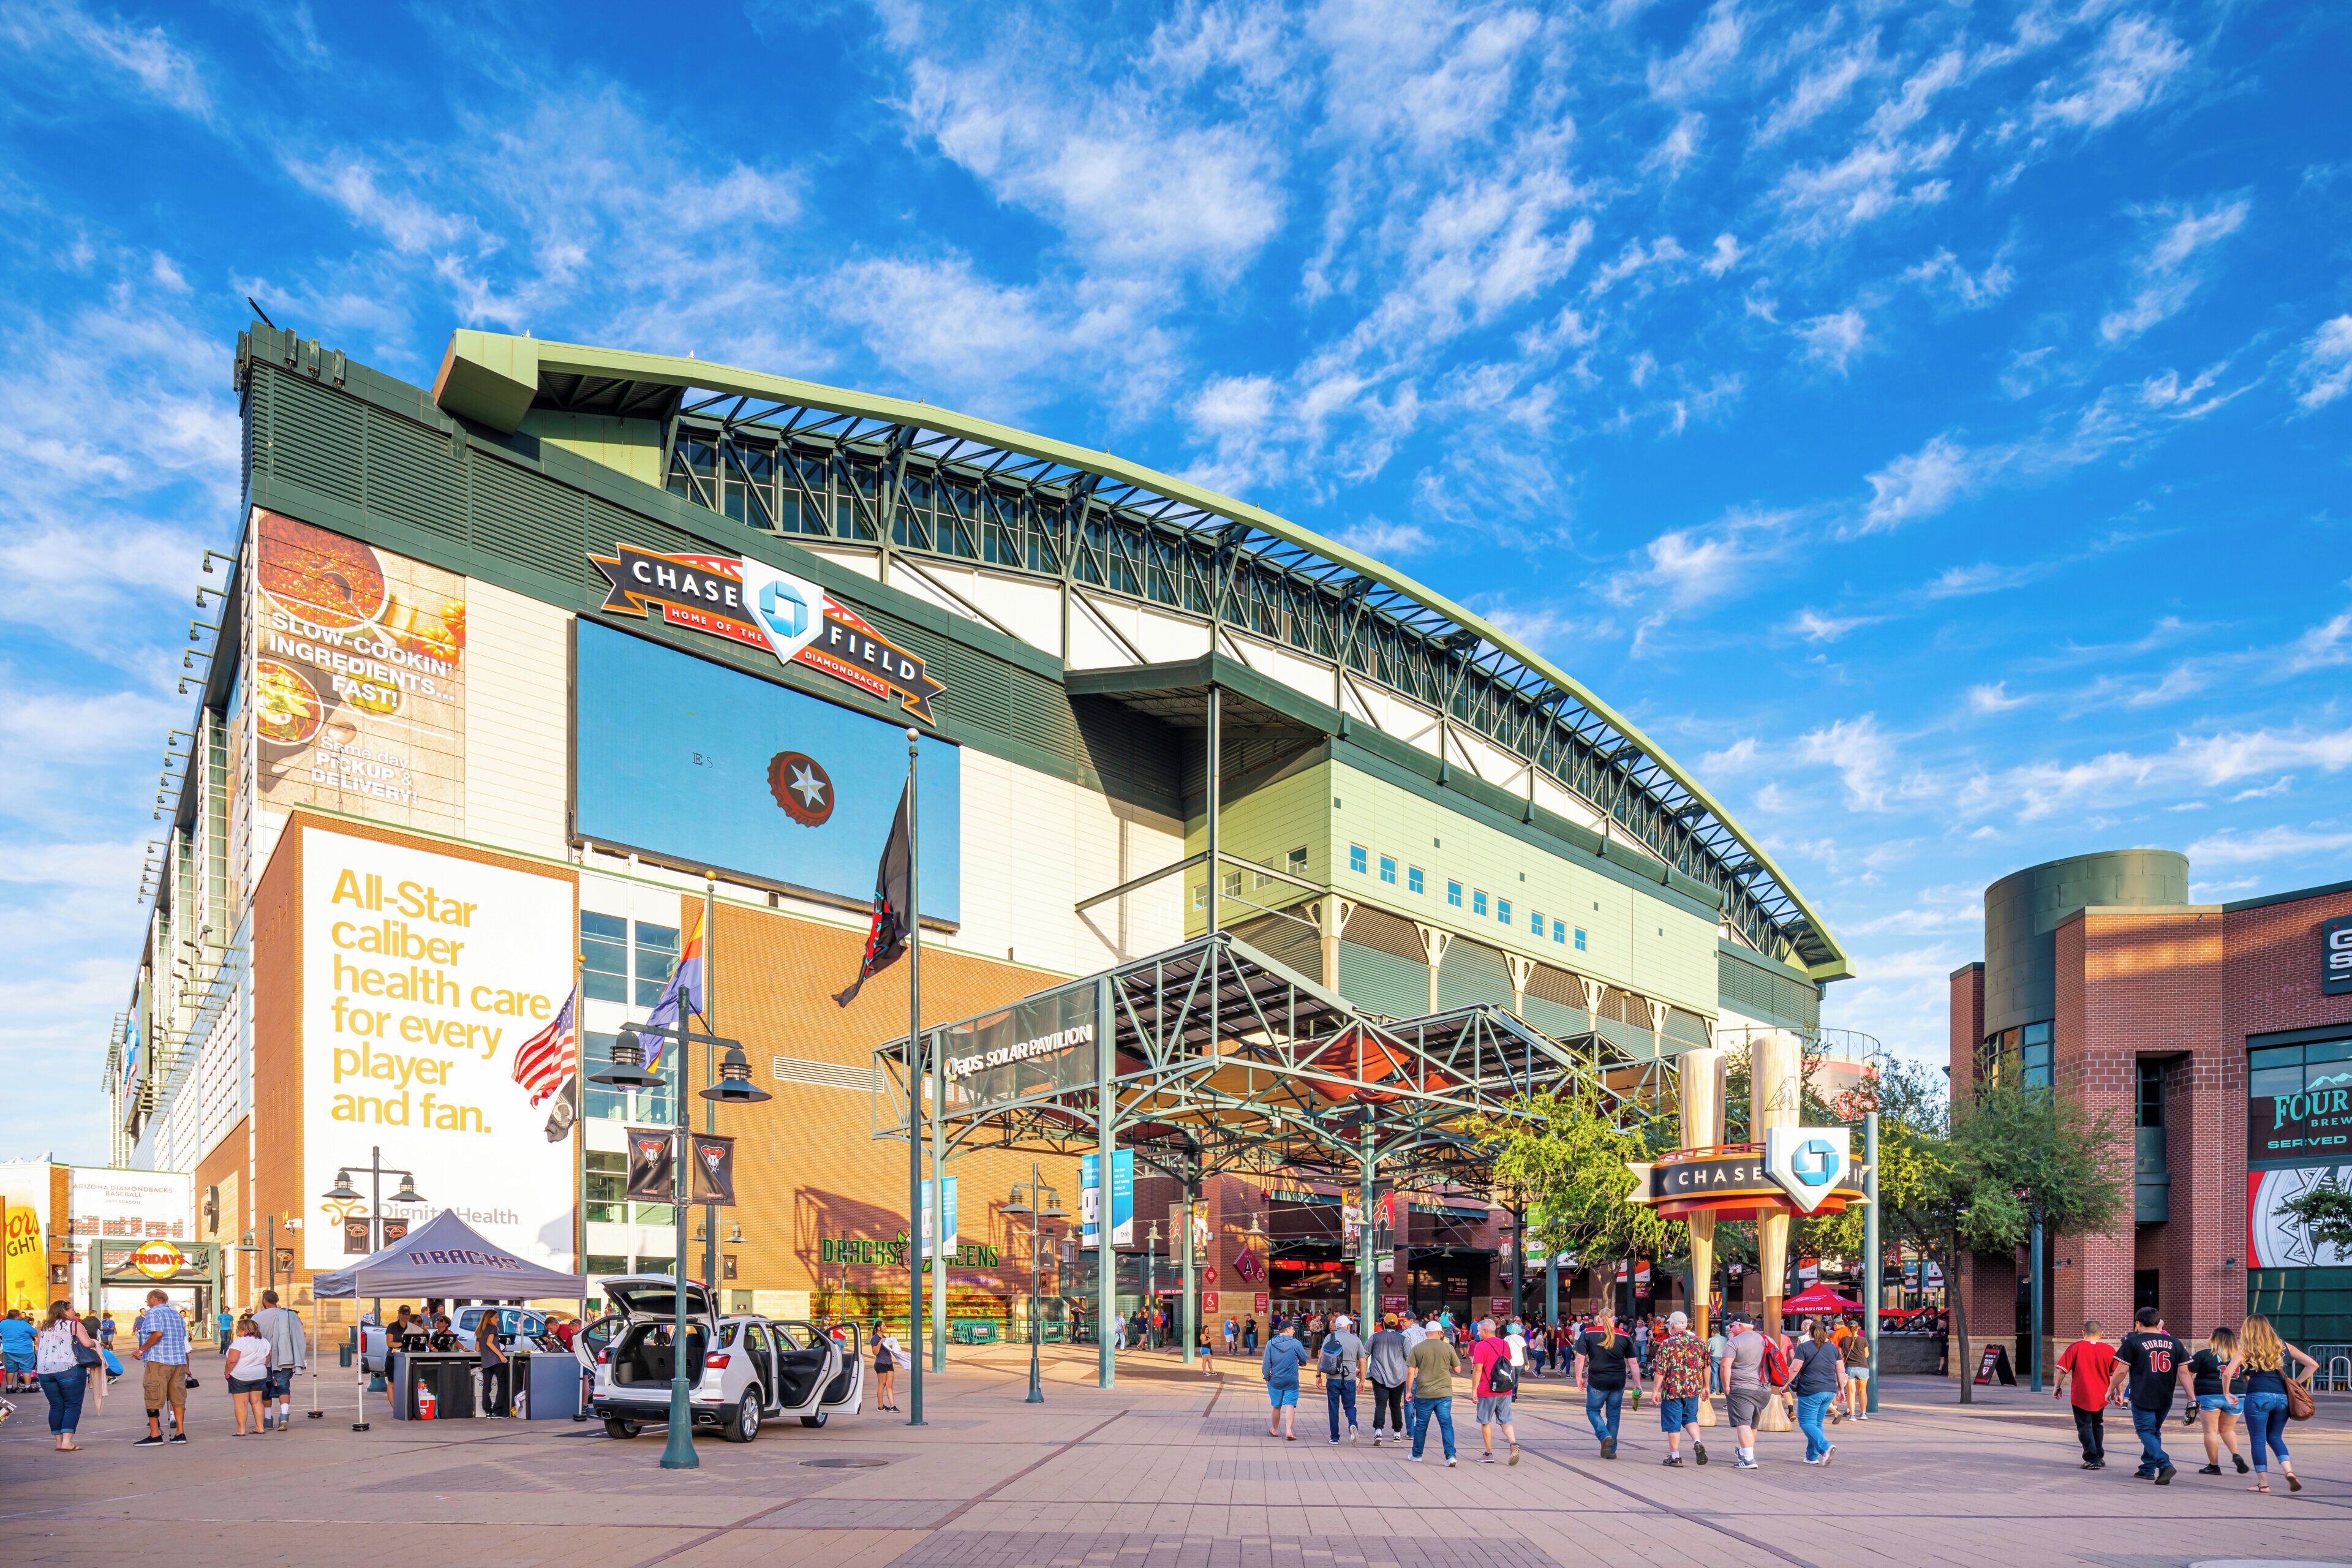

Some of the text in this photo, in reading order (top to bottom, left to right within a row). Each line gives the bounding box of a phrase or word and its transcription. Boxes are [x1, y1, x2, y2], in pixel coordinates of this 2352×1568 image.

[632, 560, 739, 608] CHASE
[271, 612, 453, 678] SLOW-COOKIN'
[671, 608, 763, 643] HOME OF THE
[270, 634, 454, 701] INGREDIENTS...
[804, 650, 885, 692] DIAMONDBACKS
[829, 628, 916, 682] FIELD
[332, 675, 398, 707] FAST!
[321, 736, 409, 772] Same day
[311, 767, 418, 805] DELIVERY!
[331, 869, 477, 927] All-Star
[331, 919, 464, 966] caliber
[334, 954, 551, 1020] health care
[331, 997, 502, 1060] for every
[986, 1042, 1029, 1068] SOLAR
[1029, 1024, 1093, 1056] PAVILION
[334, 1041, 453, 1090] player
[331, 1091, 492, 1133] and fan.
[2274, 1090, 2349, 1130] FOUR
[2267, 1136, 2347, 1149] SERVED
[1678, 1167, 1762, 1185] CHASE
[5, 1212, 40, 1238] ors
[379, 1203, 518, 1225] Dignit Health
[7, 1236, 36, 1257] GHT
[1244, 1259, 1253, 1275] A
[2142, 1340, 2173, 1351] BURGOS
[2149, 1351, 2171, 1373] 16
